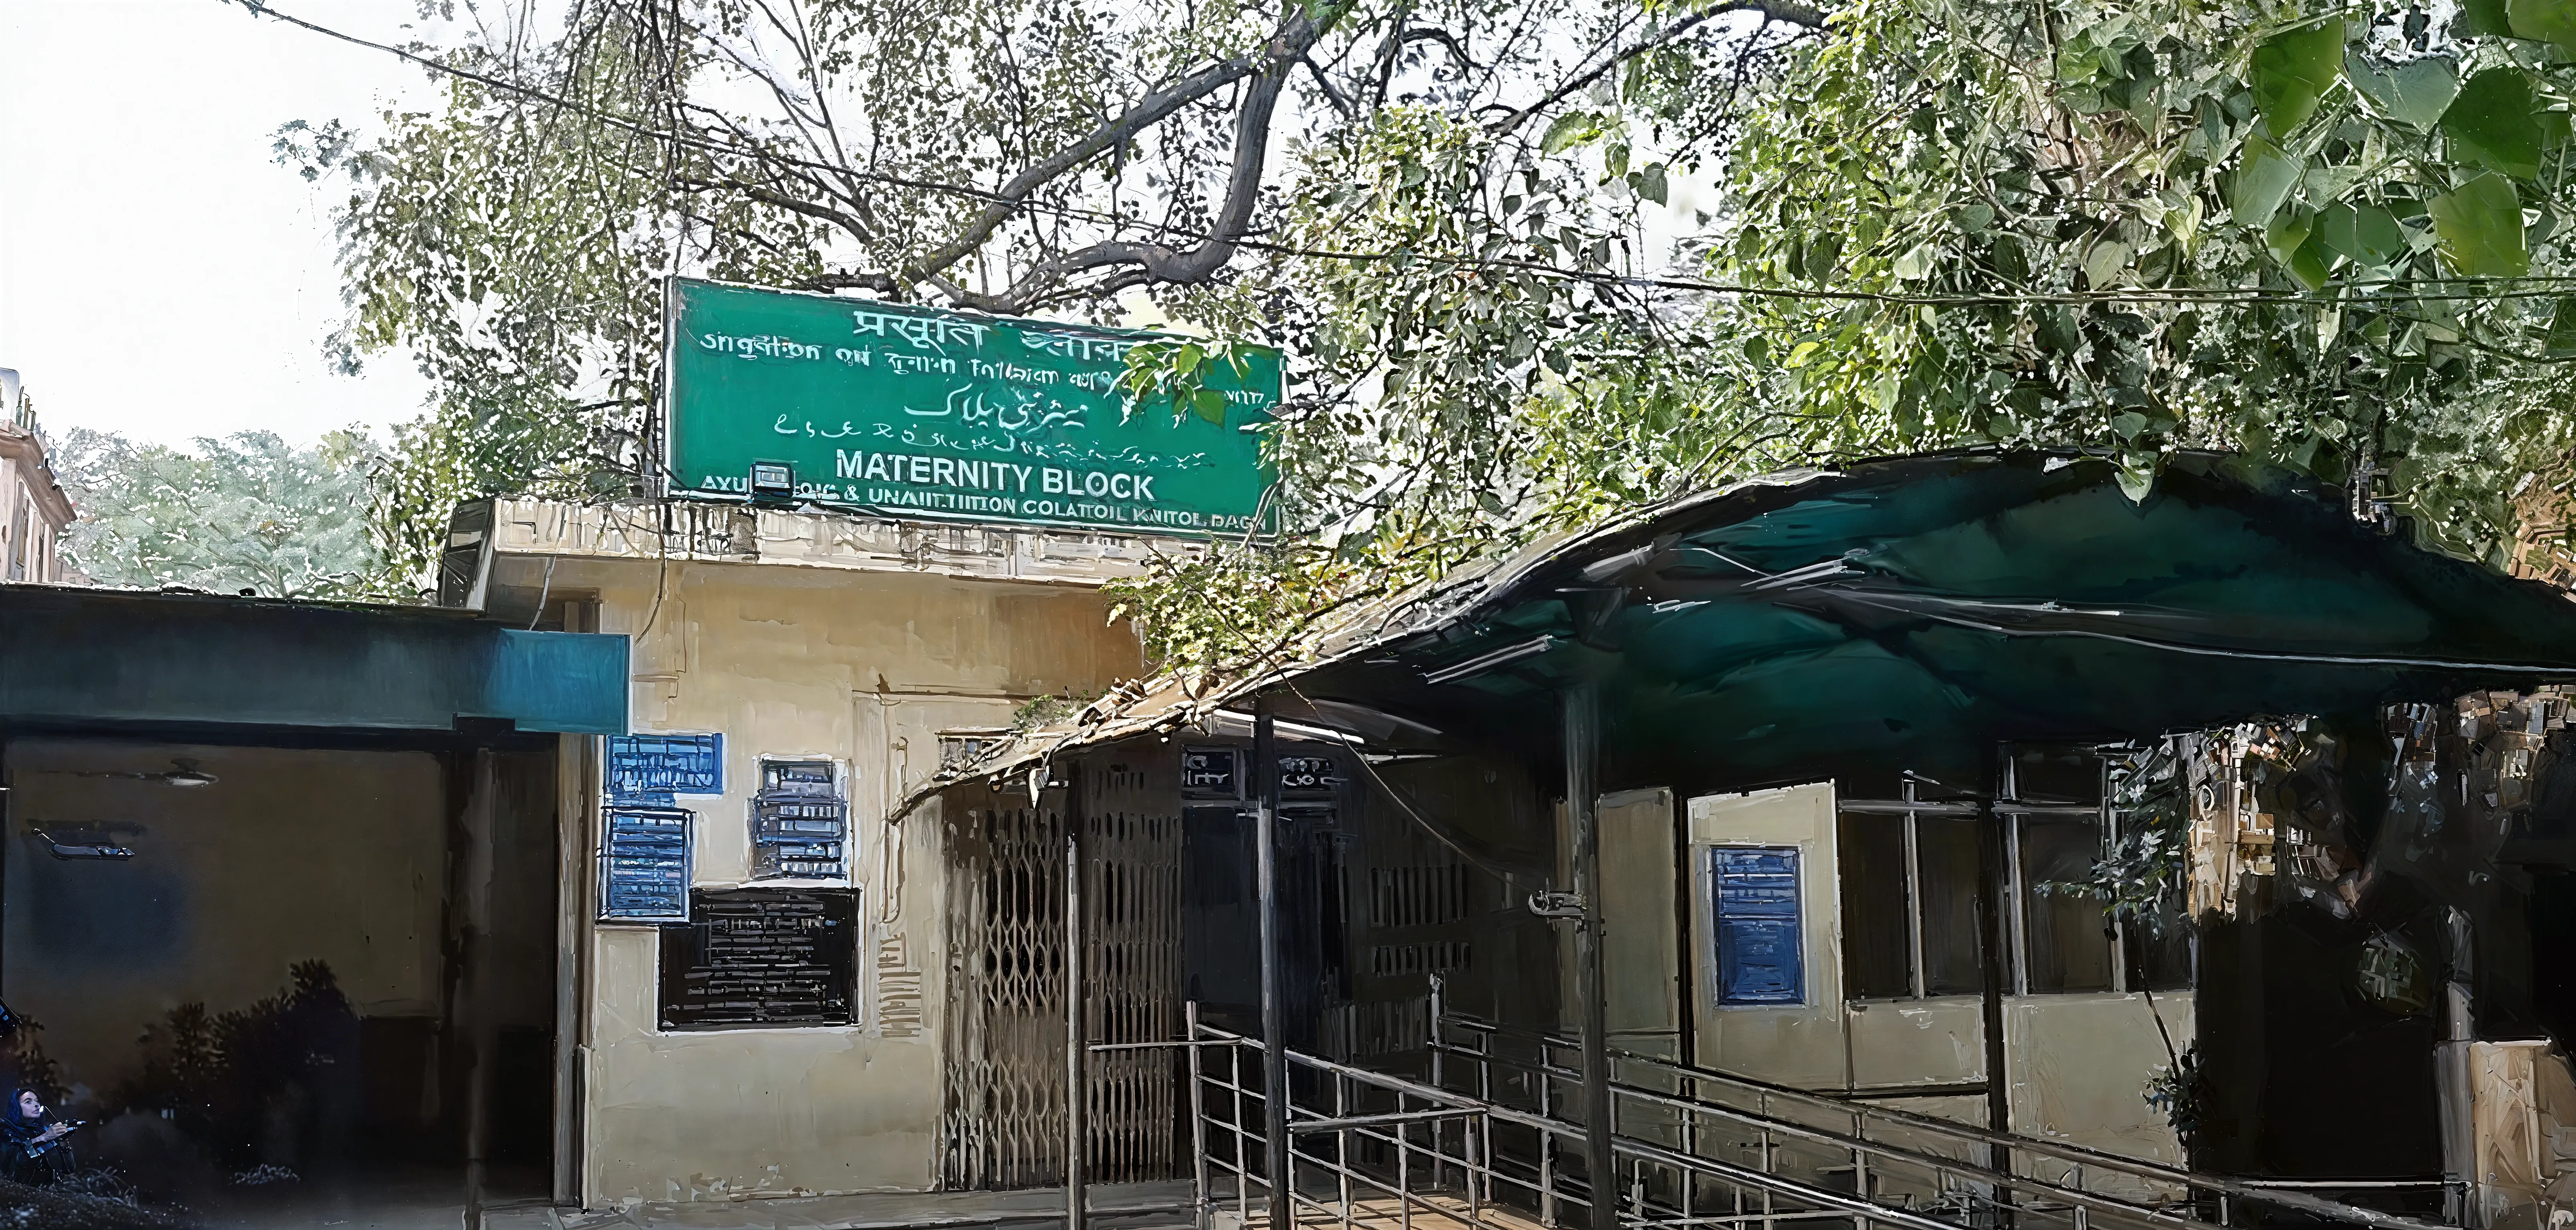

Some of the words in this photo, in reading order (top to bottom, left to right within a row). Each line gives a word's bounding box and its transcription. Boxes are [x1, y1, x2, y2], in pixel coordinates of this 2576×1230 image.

[837, 448, 1032, 493] MATERNITY
[1042, 467, 1157, 501] BLOCK
[844, 484, 860, 502] &
